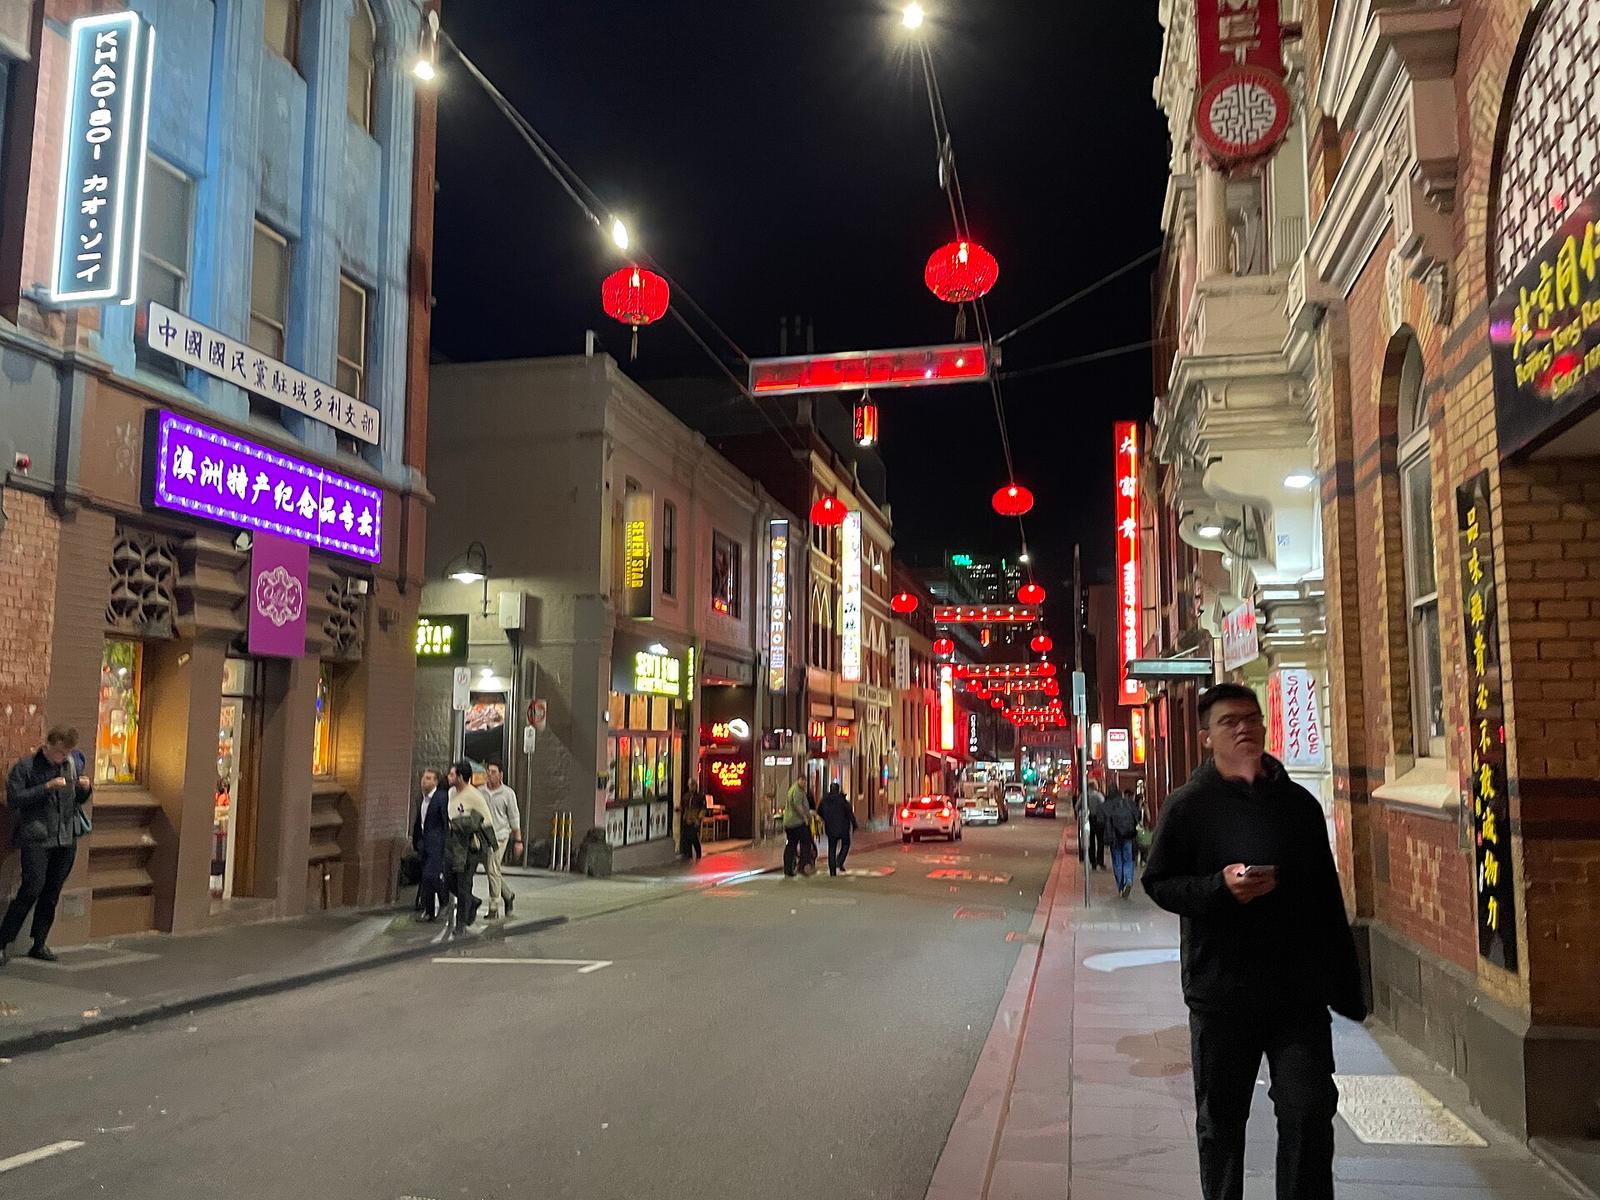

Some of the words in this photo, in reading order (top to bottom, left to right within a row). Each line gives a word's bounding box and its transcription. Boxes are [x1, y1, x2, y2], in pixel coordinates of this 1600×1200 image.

[632, 521, 645, 557] SEVEN
[631, 559, 644, 588] STAR
[1286, 675, 1301, 758] SHANGHAI
[1306, 678, 1320, 755] VILLAGE
